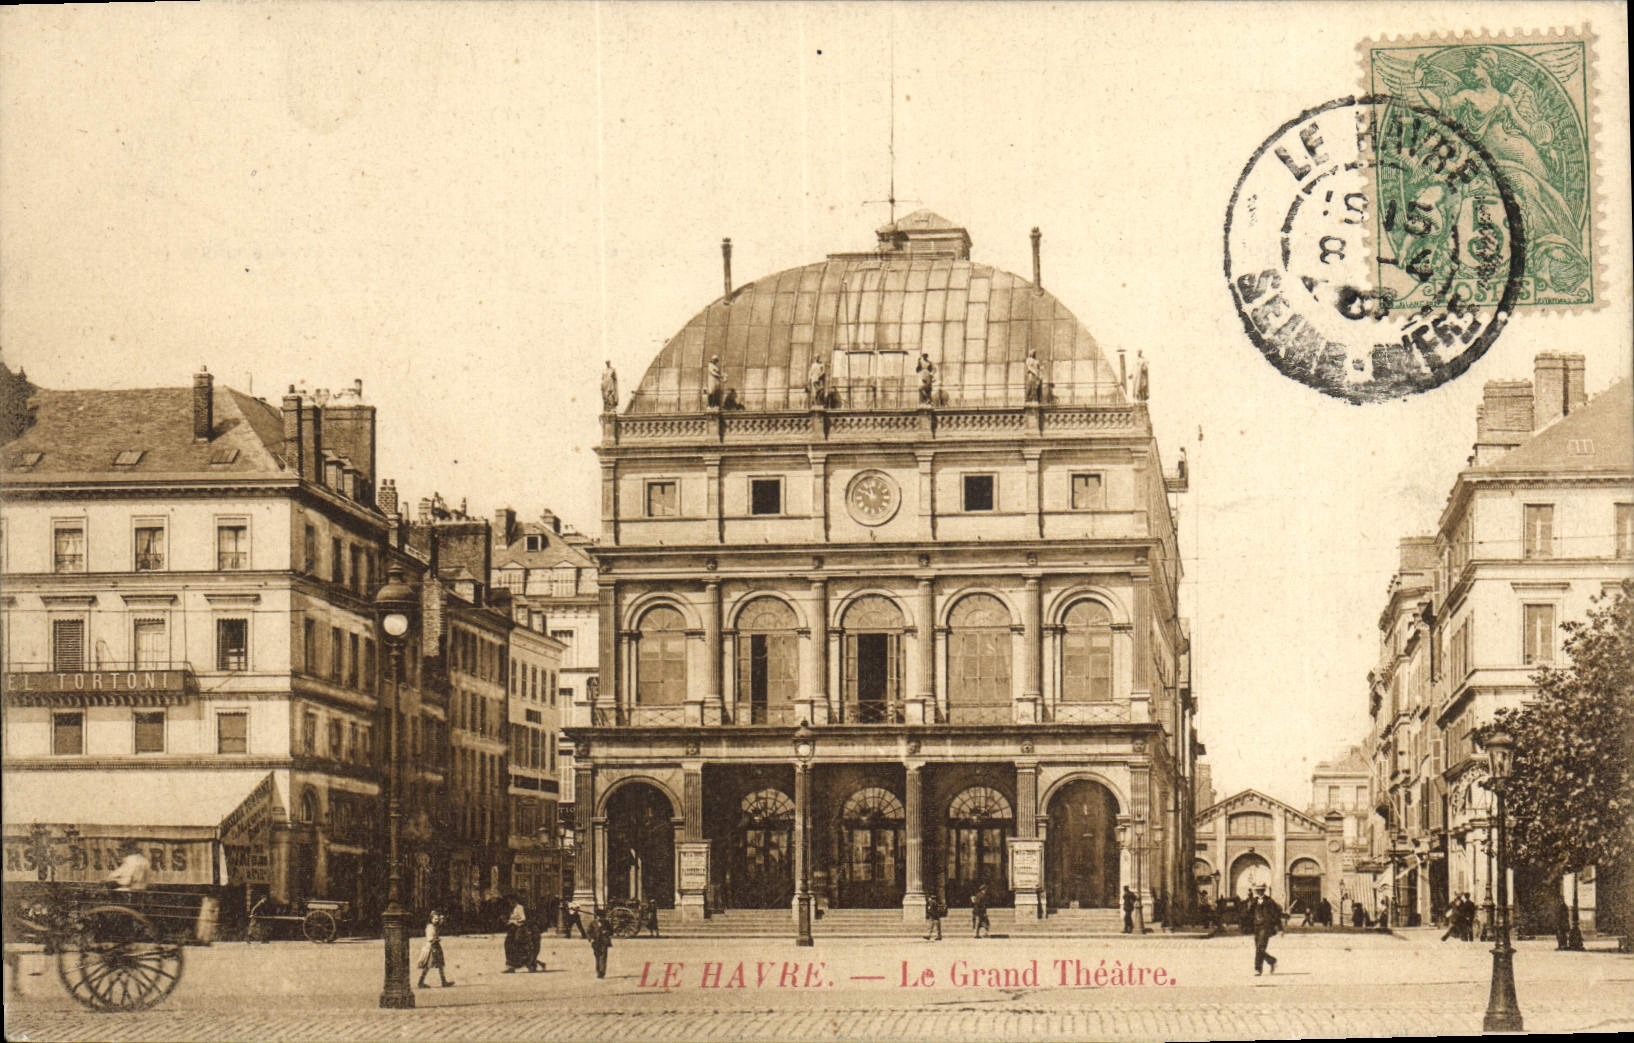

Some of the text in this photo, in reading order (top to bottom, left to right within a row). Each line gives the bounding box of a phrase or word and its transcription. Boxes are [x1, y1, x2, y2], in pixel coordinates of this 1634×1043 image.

[1275, 122, 1324, 181] LE
[56, 672, 169, 690] TORTONI
[70, 847, 188, 872] DINRS
